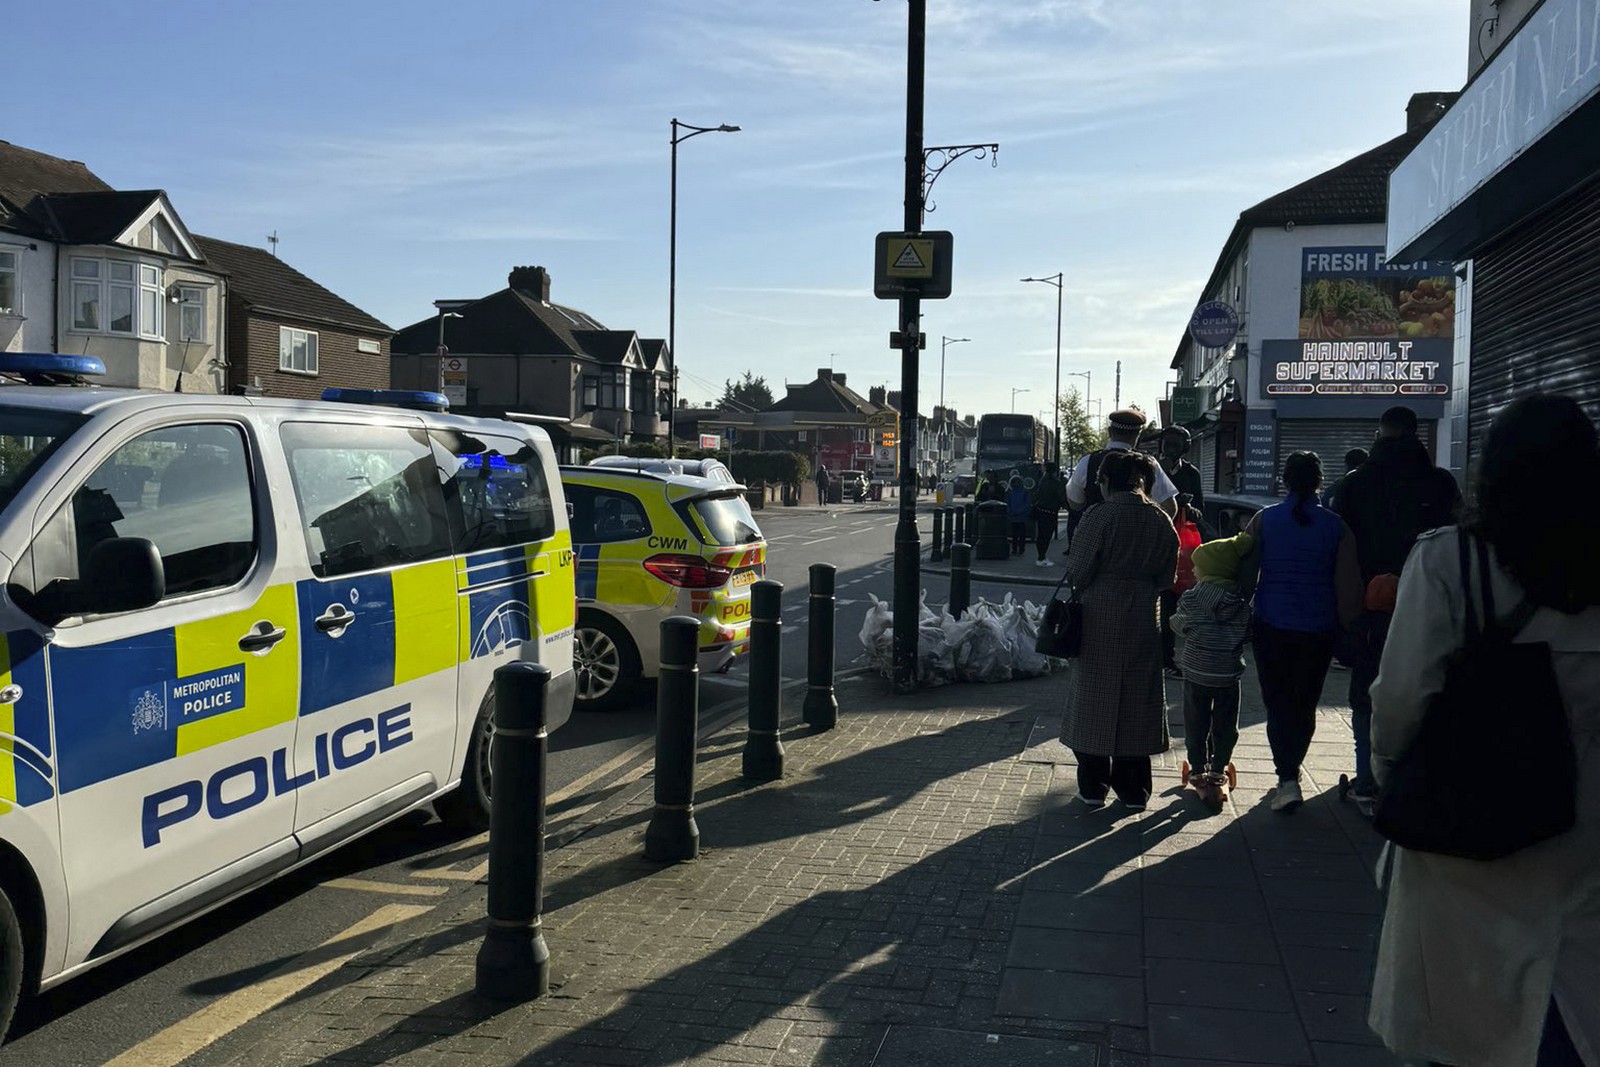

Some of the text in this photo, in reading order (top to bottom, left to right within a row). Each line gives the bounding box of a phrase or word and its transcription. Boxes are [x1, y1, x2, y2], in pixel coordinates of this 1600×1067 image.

[1427, 61, 1516, 208] SUPER
[1306, 253, 1368, 272] FRESH
[1202, 318, 1228, 326] OPEN
[1302, 341, 1412, 361] HAINAULT
[1276, 362, 1439, 381] SUPERMARKET
[647, 536, 688, 550] CWM
[558, 550, 572, 567] LKP
[173, 671, 241, 699] METROPOLITAN
[183, 691, 232, 715] POLICE
[141, 702, 414, 849] POLICE
